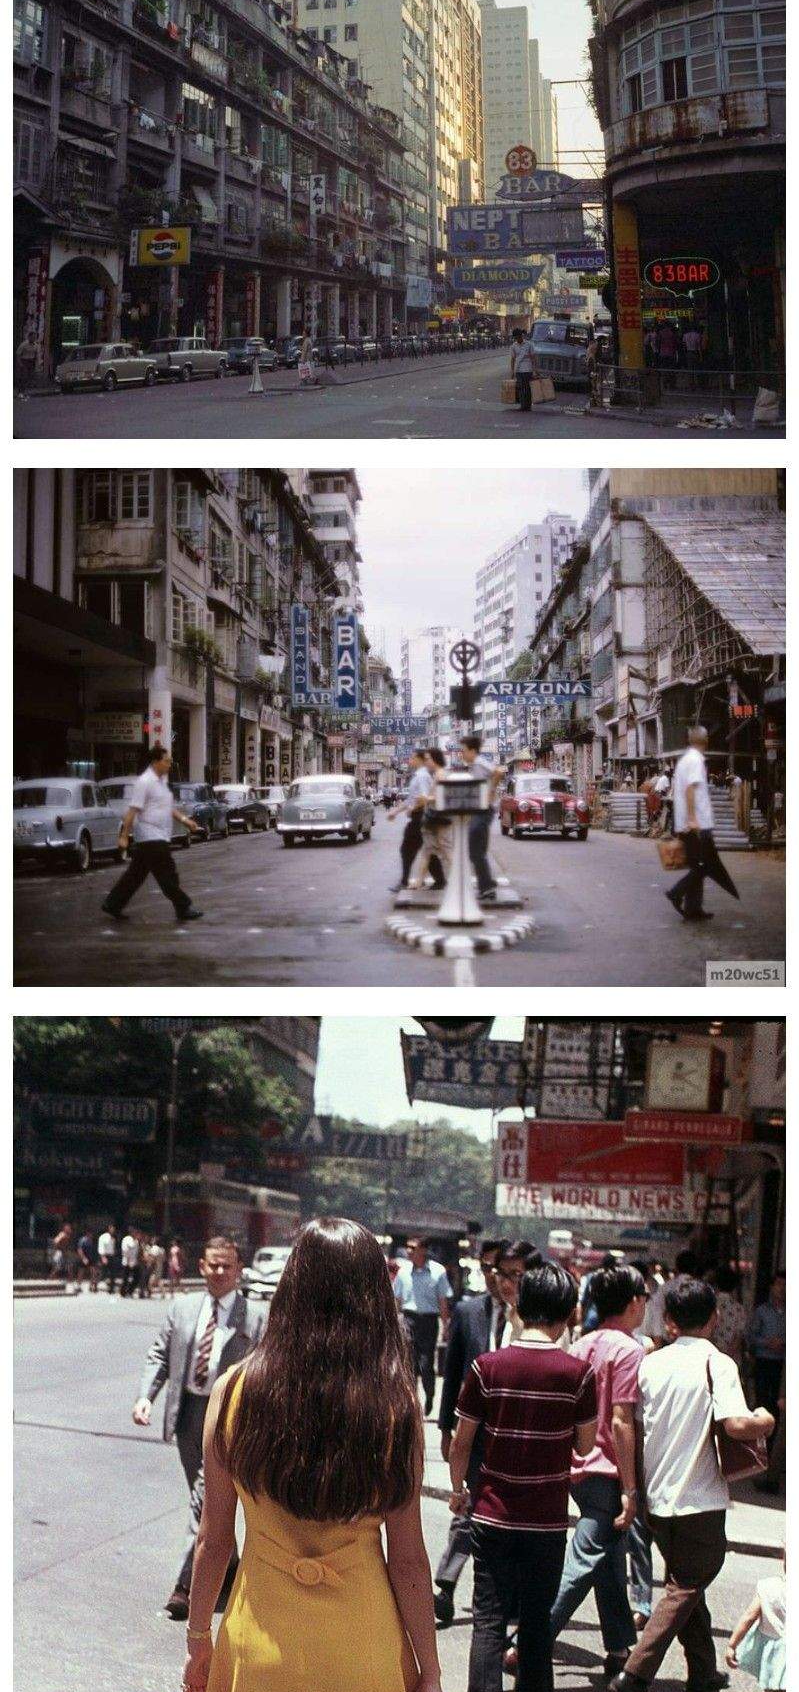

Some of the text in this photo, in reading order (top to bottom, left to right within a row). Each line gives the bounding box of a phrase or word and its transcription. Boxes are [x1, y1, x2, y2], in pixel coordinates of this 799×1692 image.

[508, 152, 533, 171] 83
[505, 176, 562, 194] BAR
[145, 241, 181, 252] PEPSI
[461, 268, 530, 283] DIAMOND
[652, 264, 710, 283] 83BAR
[336, 625, 355, 697] BAR
[484, 683, 587, 695] ARIZONA
[294, 693, 332, 705] BAR
[514, 696, 557, 706] BAR
[370, 717, 426, 728] NEPTUNE
[498, 703, 507, 747] OCEAN
[506, 1185, 541, 1205] THE
[552, 1186, 621, 1208] WORLD
[629, 1189, 684, 1211] NEWS
